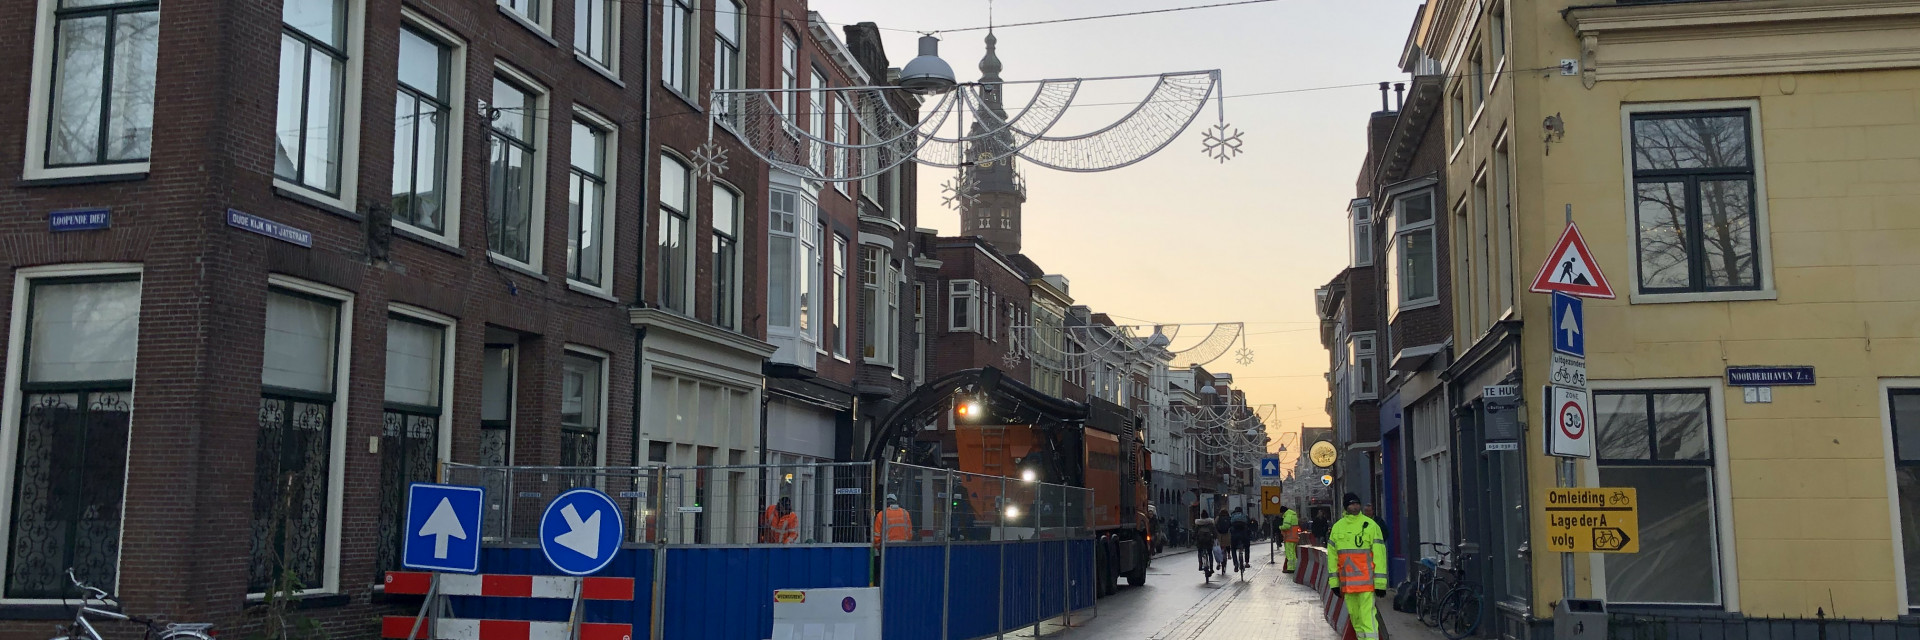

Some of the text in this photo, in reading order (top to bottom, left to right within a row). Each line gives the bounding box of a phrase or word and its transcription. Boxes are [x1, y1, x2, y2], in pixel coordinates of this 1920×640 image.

[53, 213, 106, 226] LOOPENDE DIEP
[232, 213, 249, 226] OUDE
[250, 219, 264, 231] KIJK
[265, 223, 272, 233] IN
[278, 228, 308, 242] JATSTRAAT
[1731, 372, 1793, 381] NOORDERHAVEN
[1484, 387, 1496, 396] TE
[1565, 391, 1579, 400] ZONE
[1549, 491, 1605, 507] Omleiding
[1551, 513, 1607, 530] Lage der A
[1551, 533, 1575, 549] volg
